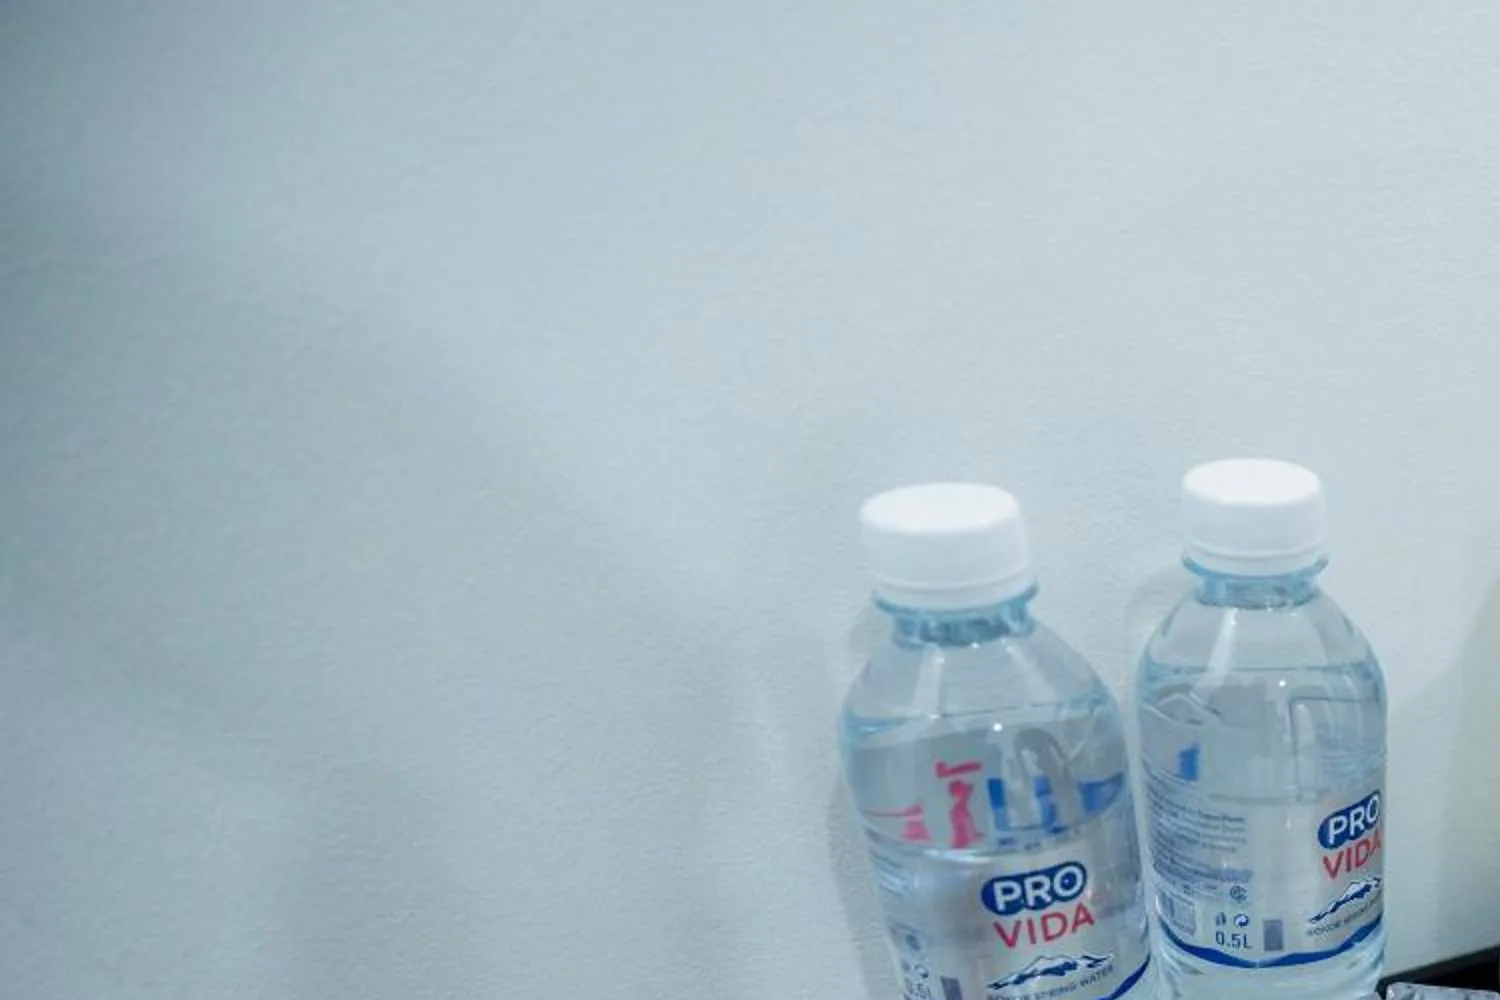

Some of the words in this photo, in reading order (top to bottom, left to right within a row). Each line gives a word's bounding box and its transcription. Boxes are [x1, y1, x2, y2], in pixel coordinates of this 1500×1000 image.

[1327, 795, 1380, 844] PRO
[1323, 829, 1381, 880] VIDA
[993, 863, 1085, 911] PRO
[993, 902, 1095, 948] VIDA
[1215, 930, 1253, 949] 0.5L
[1080, 964, 1114, 992] WATER
